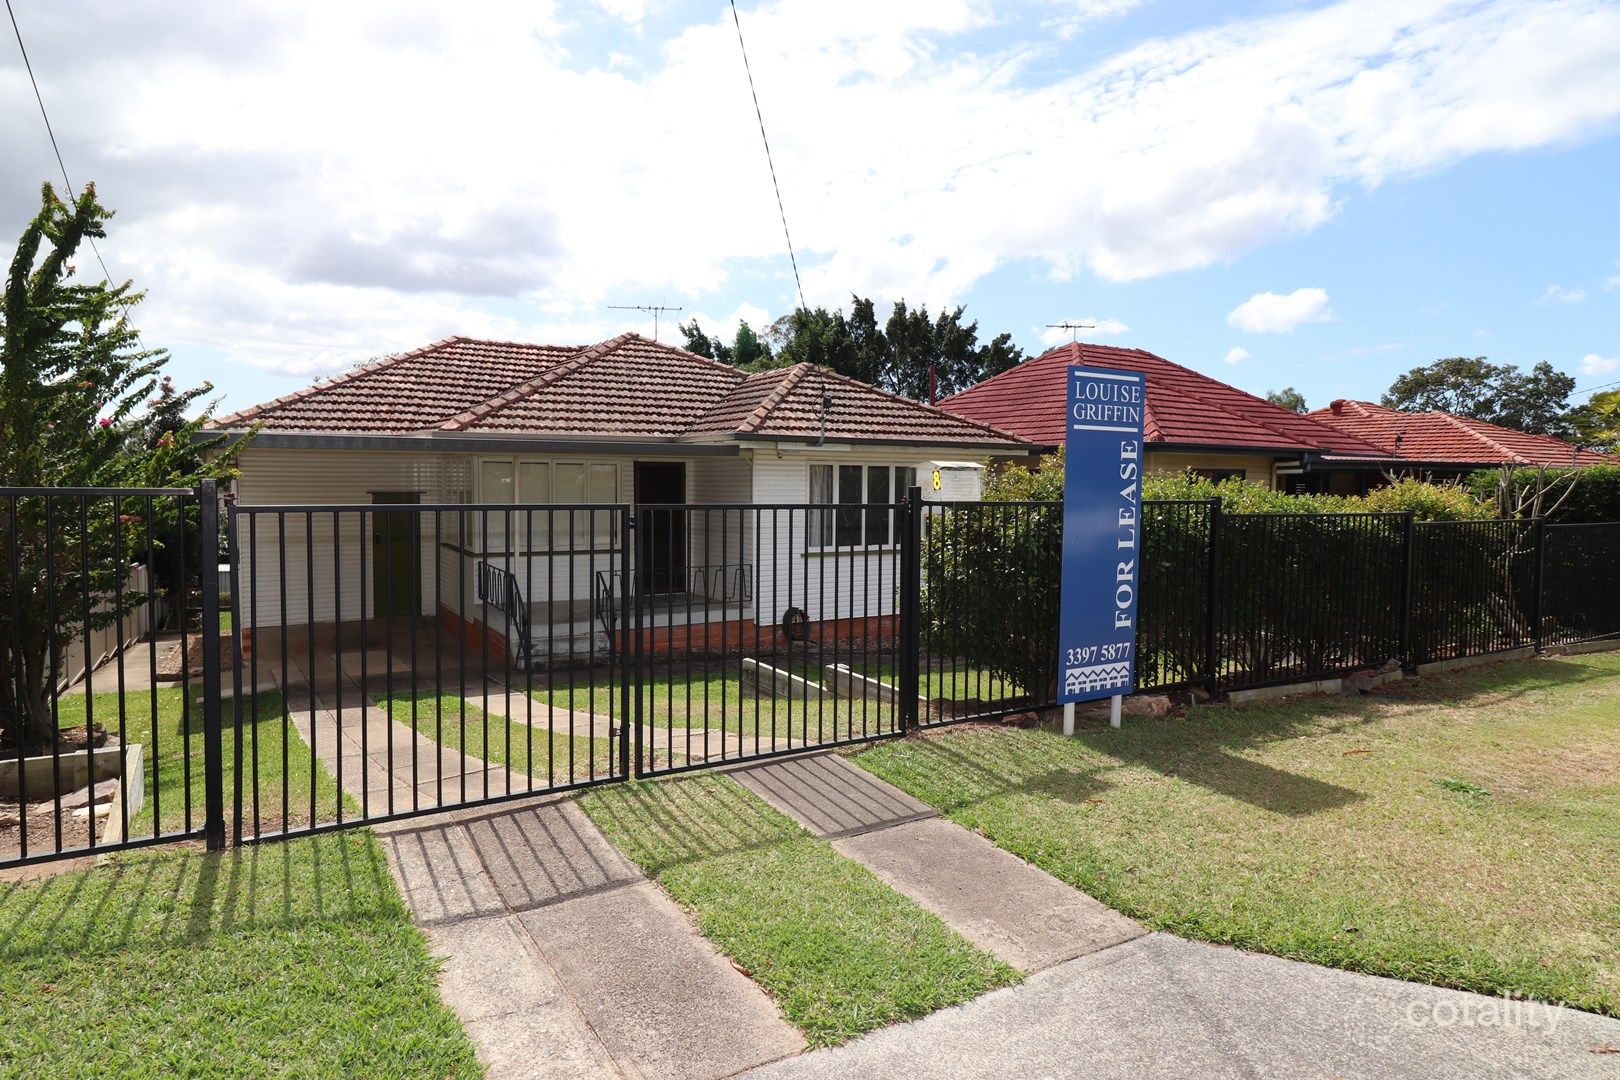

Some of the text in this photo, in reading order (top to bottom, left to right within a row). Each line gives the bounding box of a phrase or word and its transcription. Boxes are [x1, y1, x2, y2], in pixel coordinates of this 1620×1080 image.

[1075, 381, 1141, 403] LOUISE
[1073, 402, 1140, 423] GRIFFIN
[932, 470, 941, 490] 8
[1114, 440, 1138, 631] FOR LEASE
[1066, 642, 1131, 666] 3397 5877
